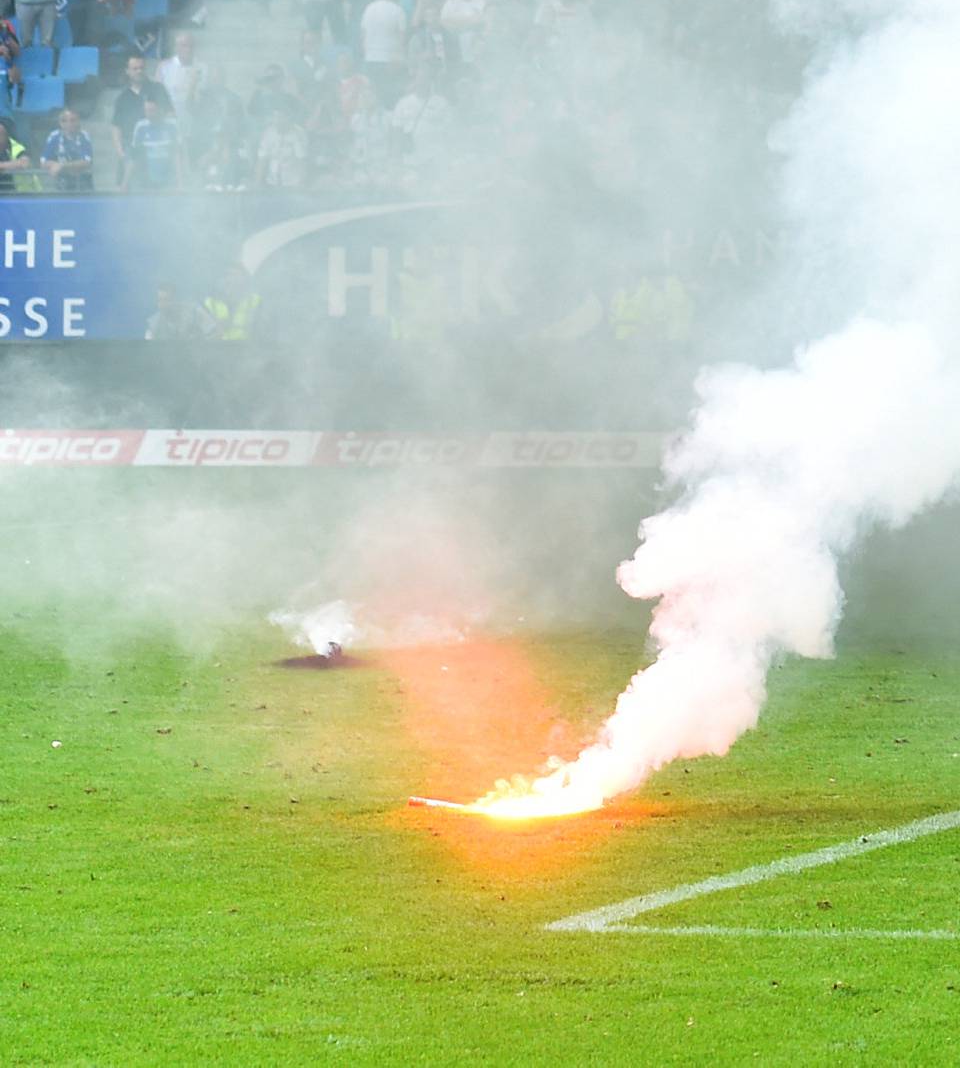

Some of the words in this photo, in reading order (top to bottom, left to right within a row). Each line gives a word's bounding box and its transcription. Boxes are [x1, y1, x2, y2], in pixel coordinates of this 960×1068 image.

[5, 229, 76, 268] HE
[0, 429, 121, 465] tipico
[166, 430, 290, 466] tipico
[337, 431, 465, 466] tipico
[511, 431, 638, 466] tipico
